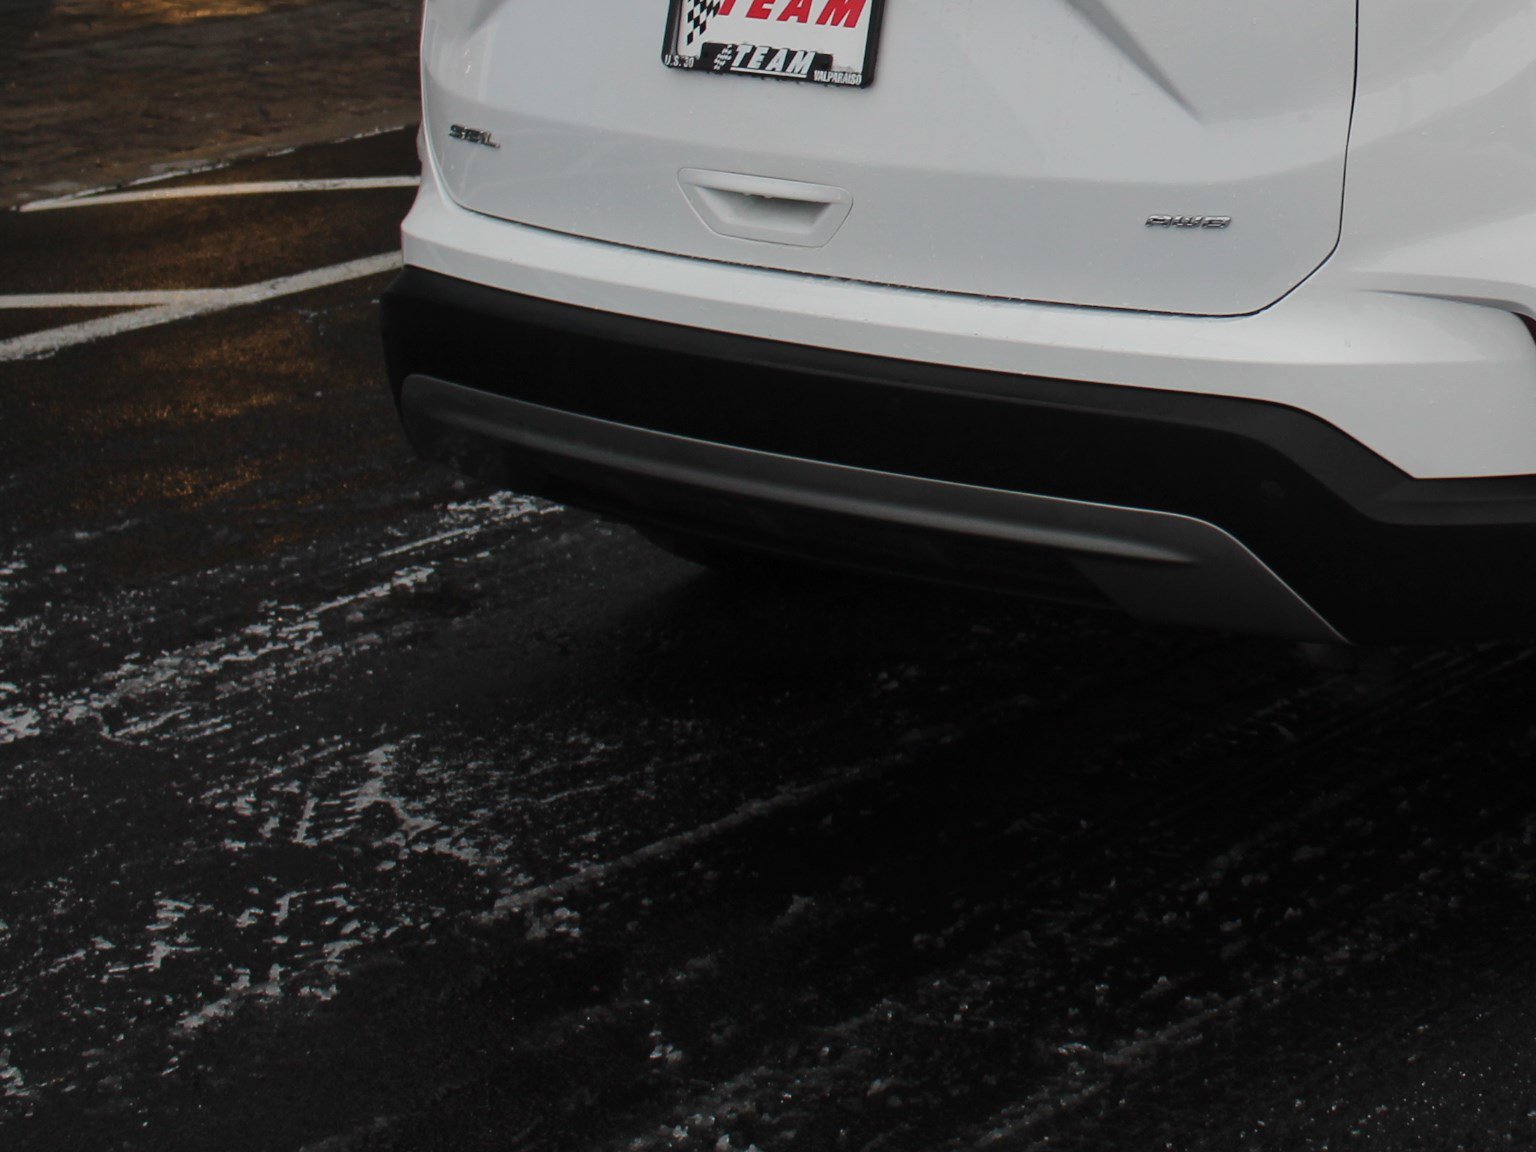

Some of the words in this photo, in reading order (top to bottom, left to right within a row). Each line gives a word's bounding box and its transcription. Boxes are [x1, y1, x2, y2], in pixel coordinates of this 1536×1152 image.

[731, 44, 816, 74] TEAM
[813, 69, 863, 86] VALPARAISO
[1144, 214, 1232, 229] AWD
